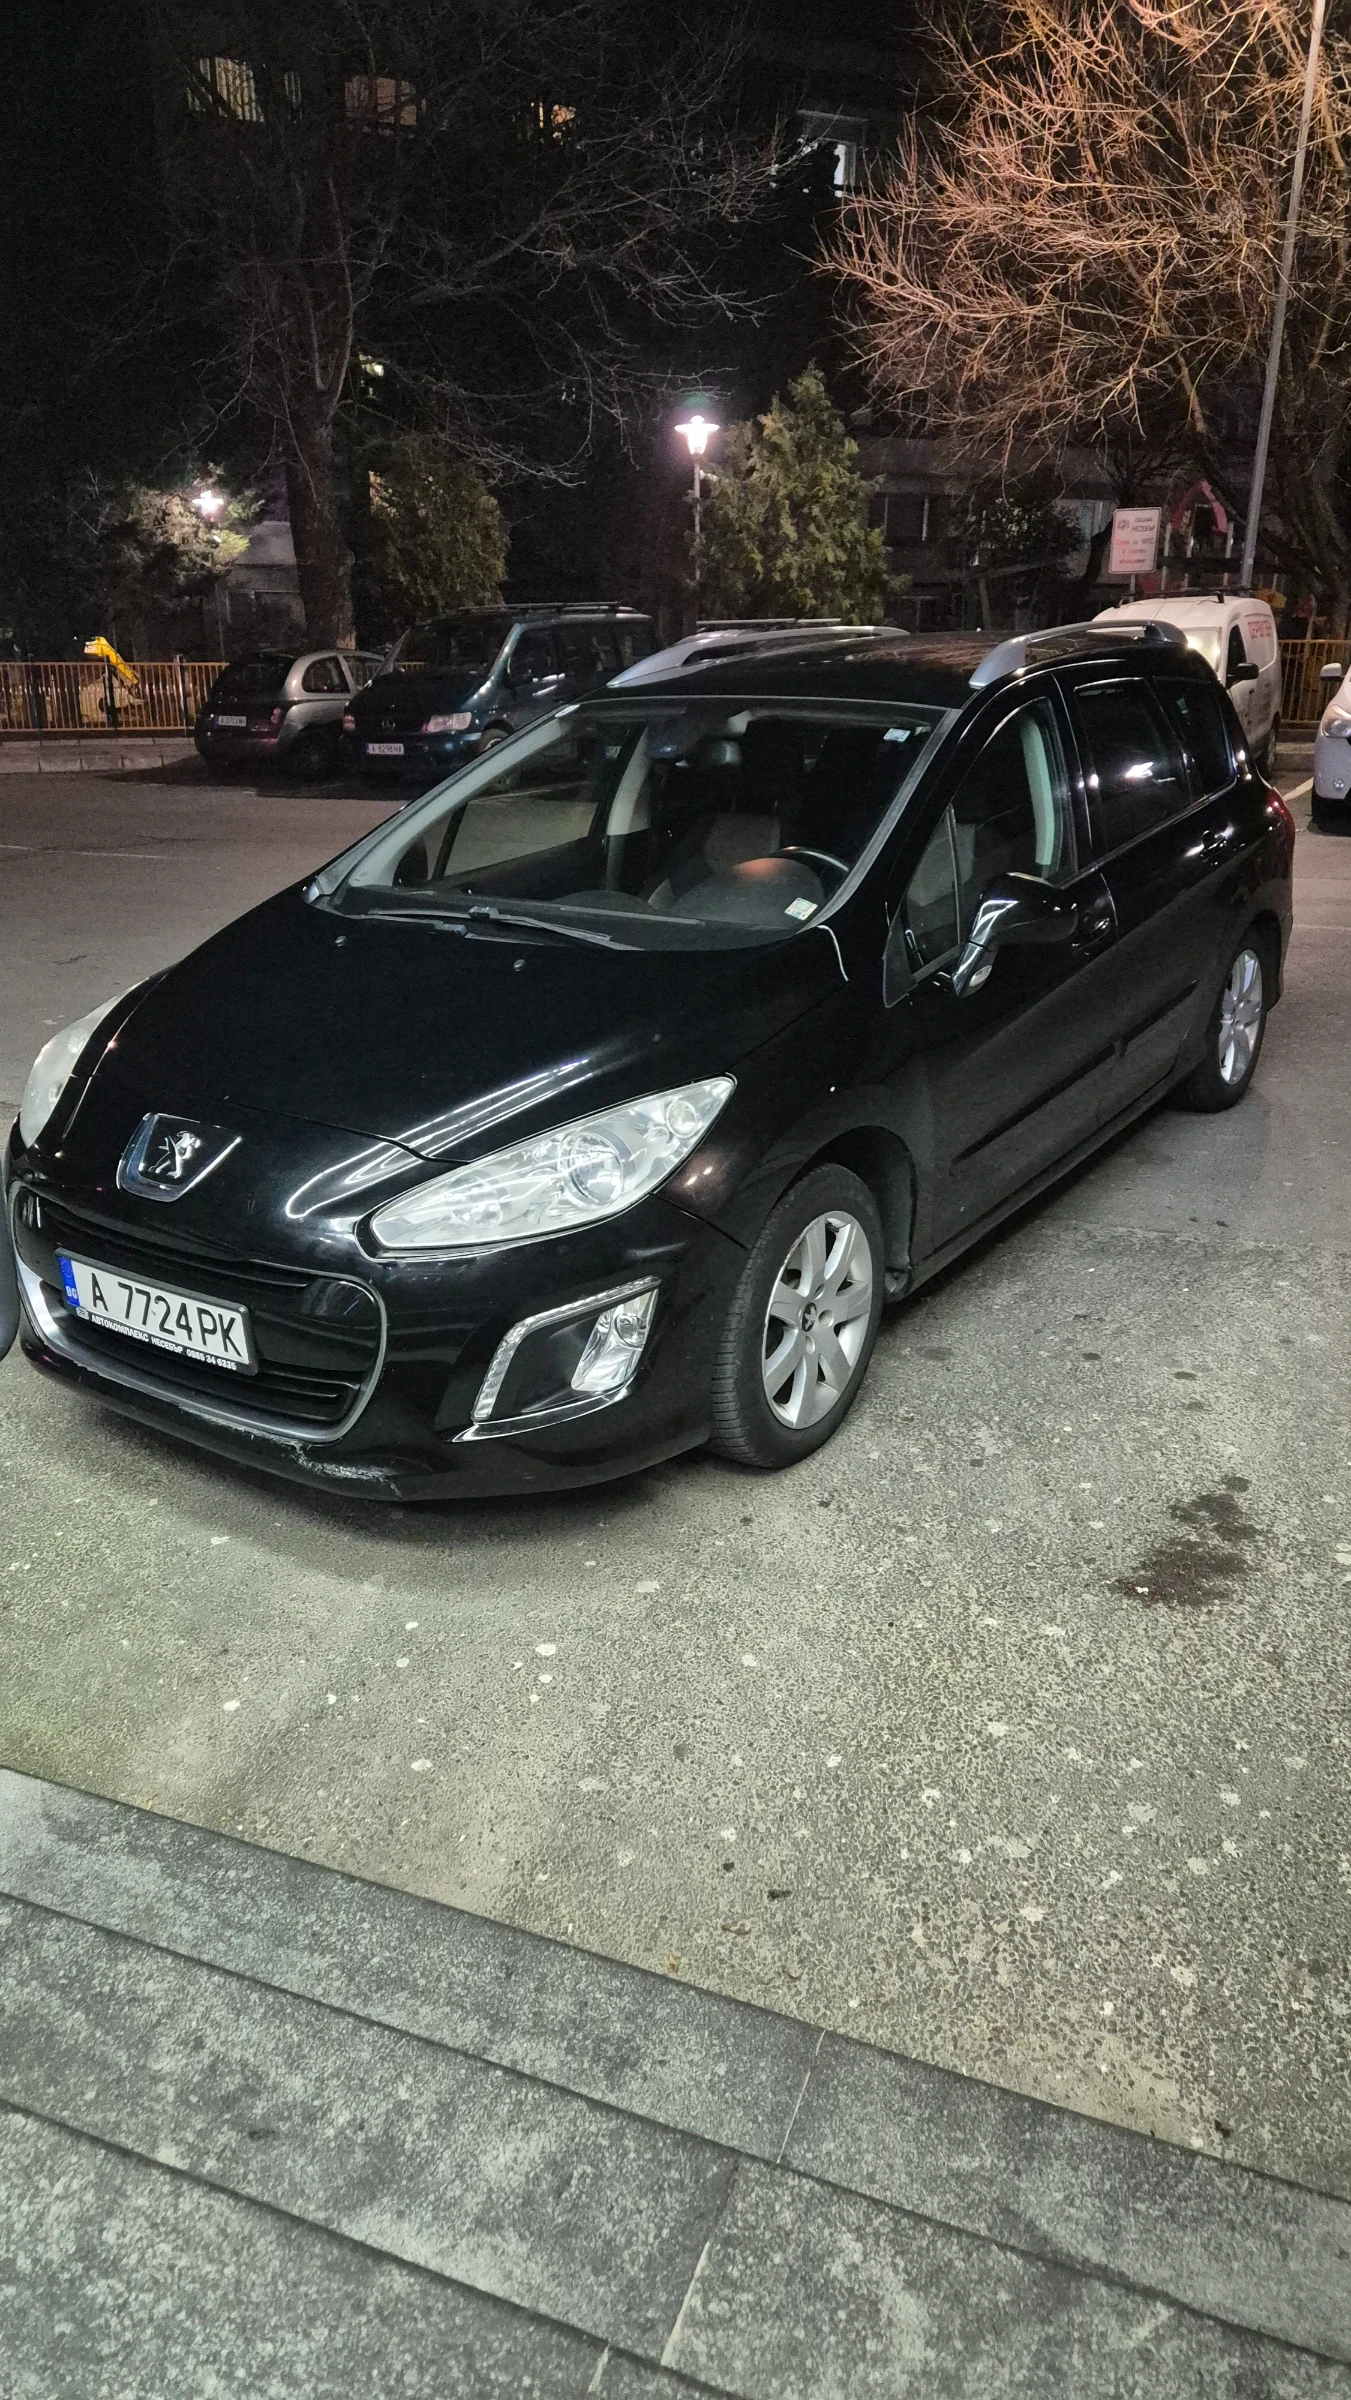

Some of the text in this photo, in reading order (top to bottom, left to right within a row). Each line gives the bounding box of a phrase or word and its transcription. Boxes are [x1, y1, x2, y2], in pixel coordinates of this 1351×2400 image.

[65, 1285, 78, 1300] BG
[91, 1272, 109, 1312] A
[91, 1314, 149, 1342] АВТОКОМПЛЕКС
[150, 1336, 183, 1354] НЕСЕБЪР
[205, 1354, 217, 1366] 34
